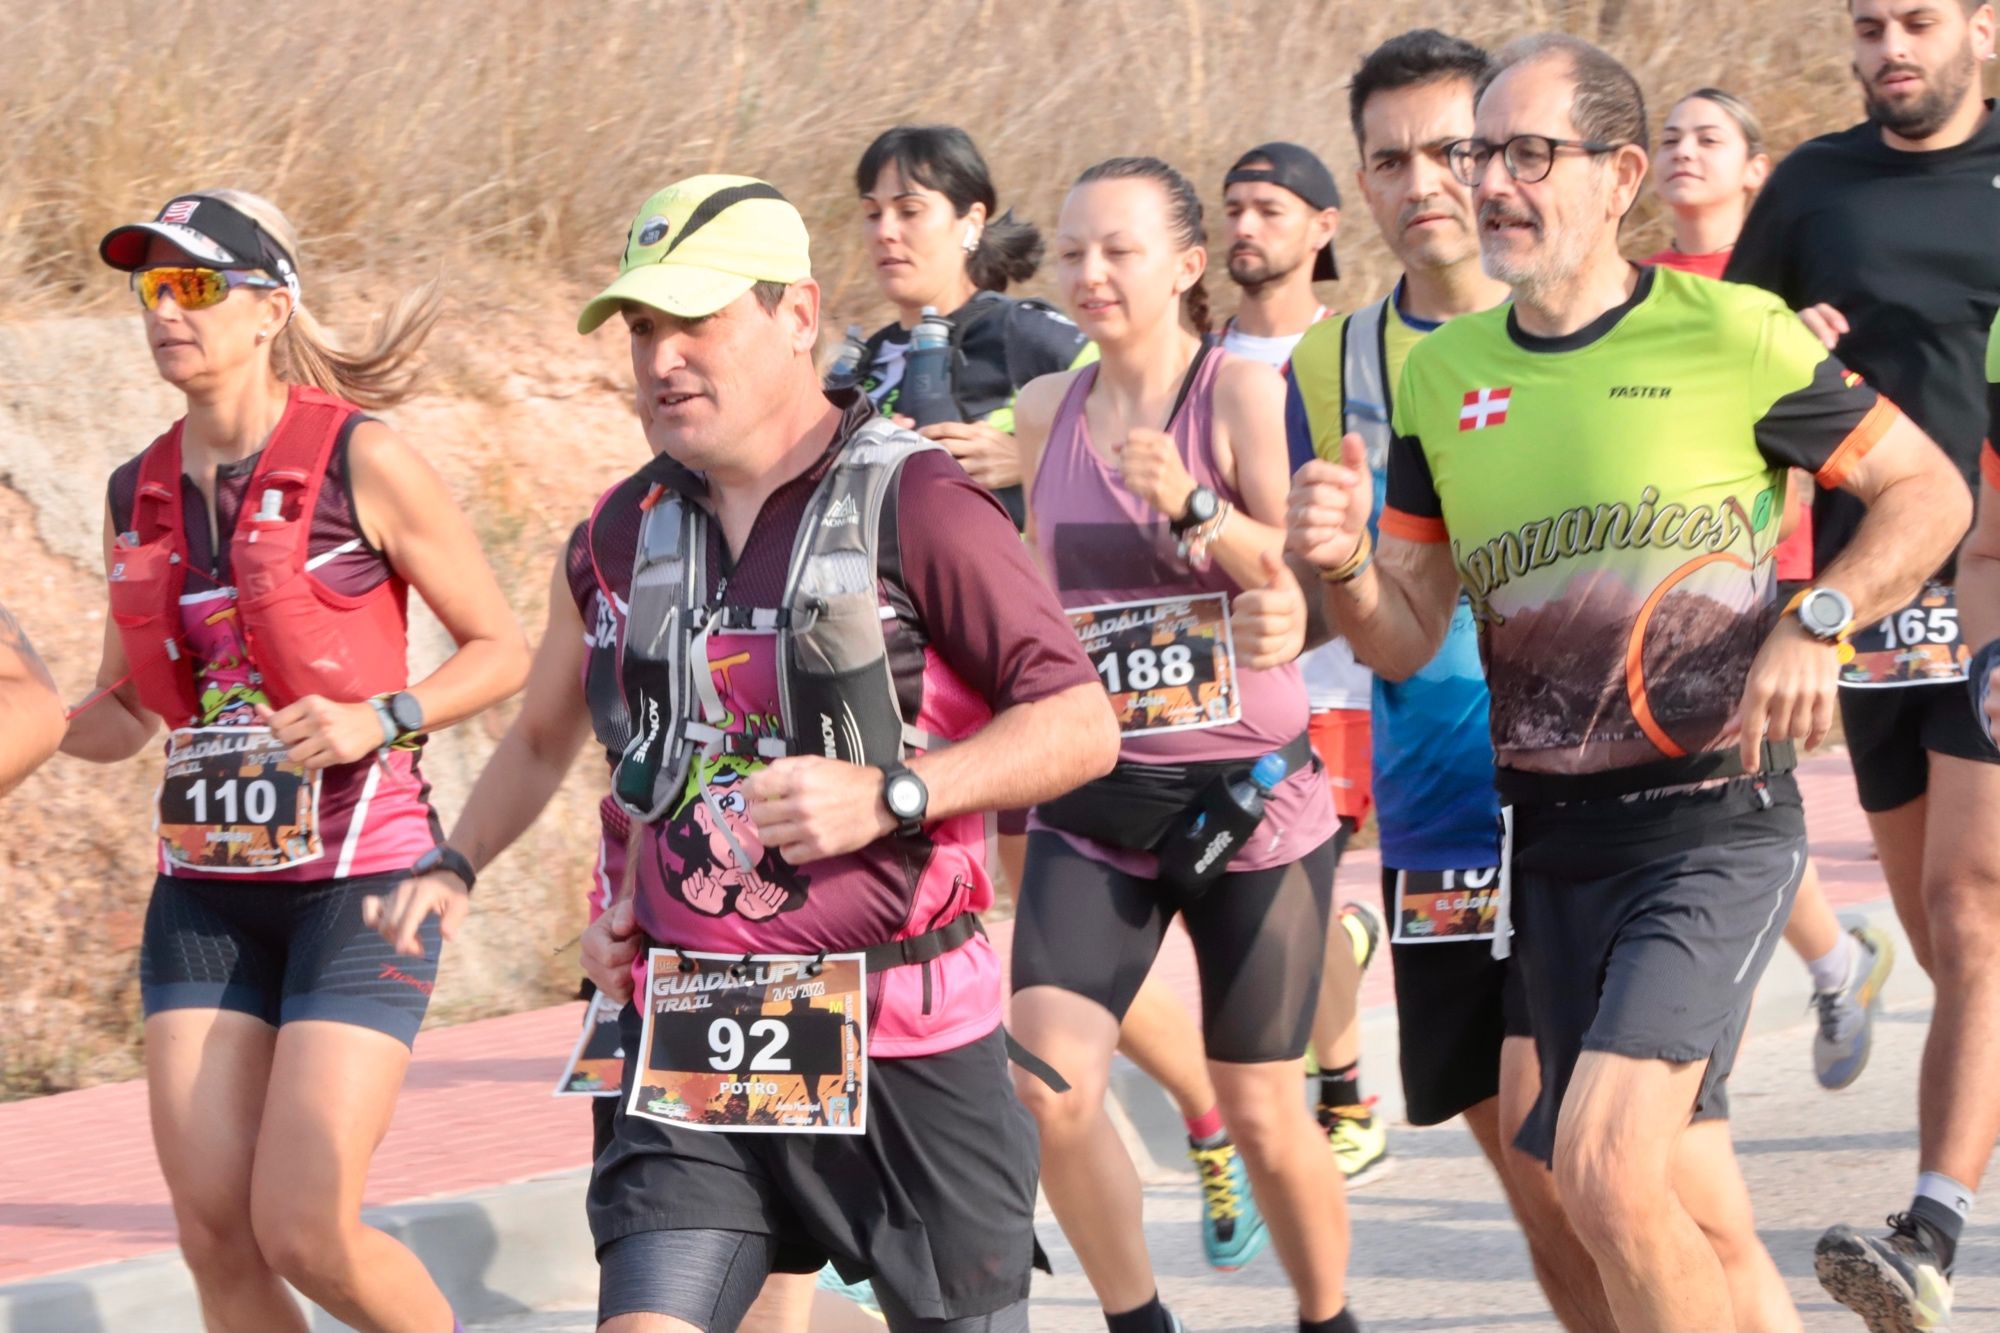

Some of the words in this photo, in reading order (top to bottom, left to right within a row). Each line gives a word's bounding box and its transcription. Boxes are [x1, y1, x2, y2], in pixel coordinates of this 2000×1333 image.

[1609, 386, 1672, 399] FASTER
[1075, 601, 1192, 641] UADALUPE
[1880, 608, 1960, 650] 165
[1097, 643, 1195, 694] 188
[185, 778, 277, 824] 110
[656, 994, 713, 1014] TRAIL
[829, 1000, 843, 1013] M
[707, 1017, 792, 1072] 92
[719, 1081, 779, 1096] POTRO
